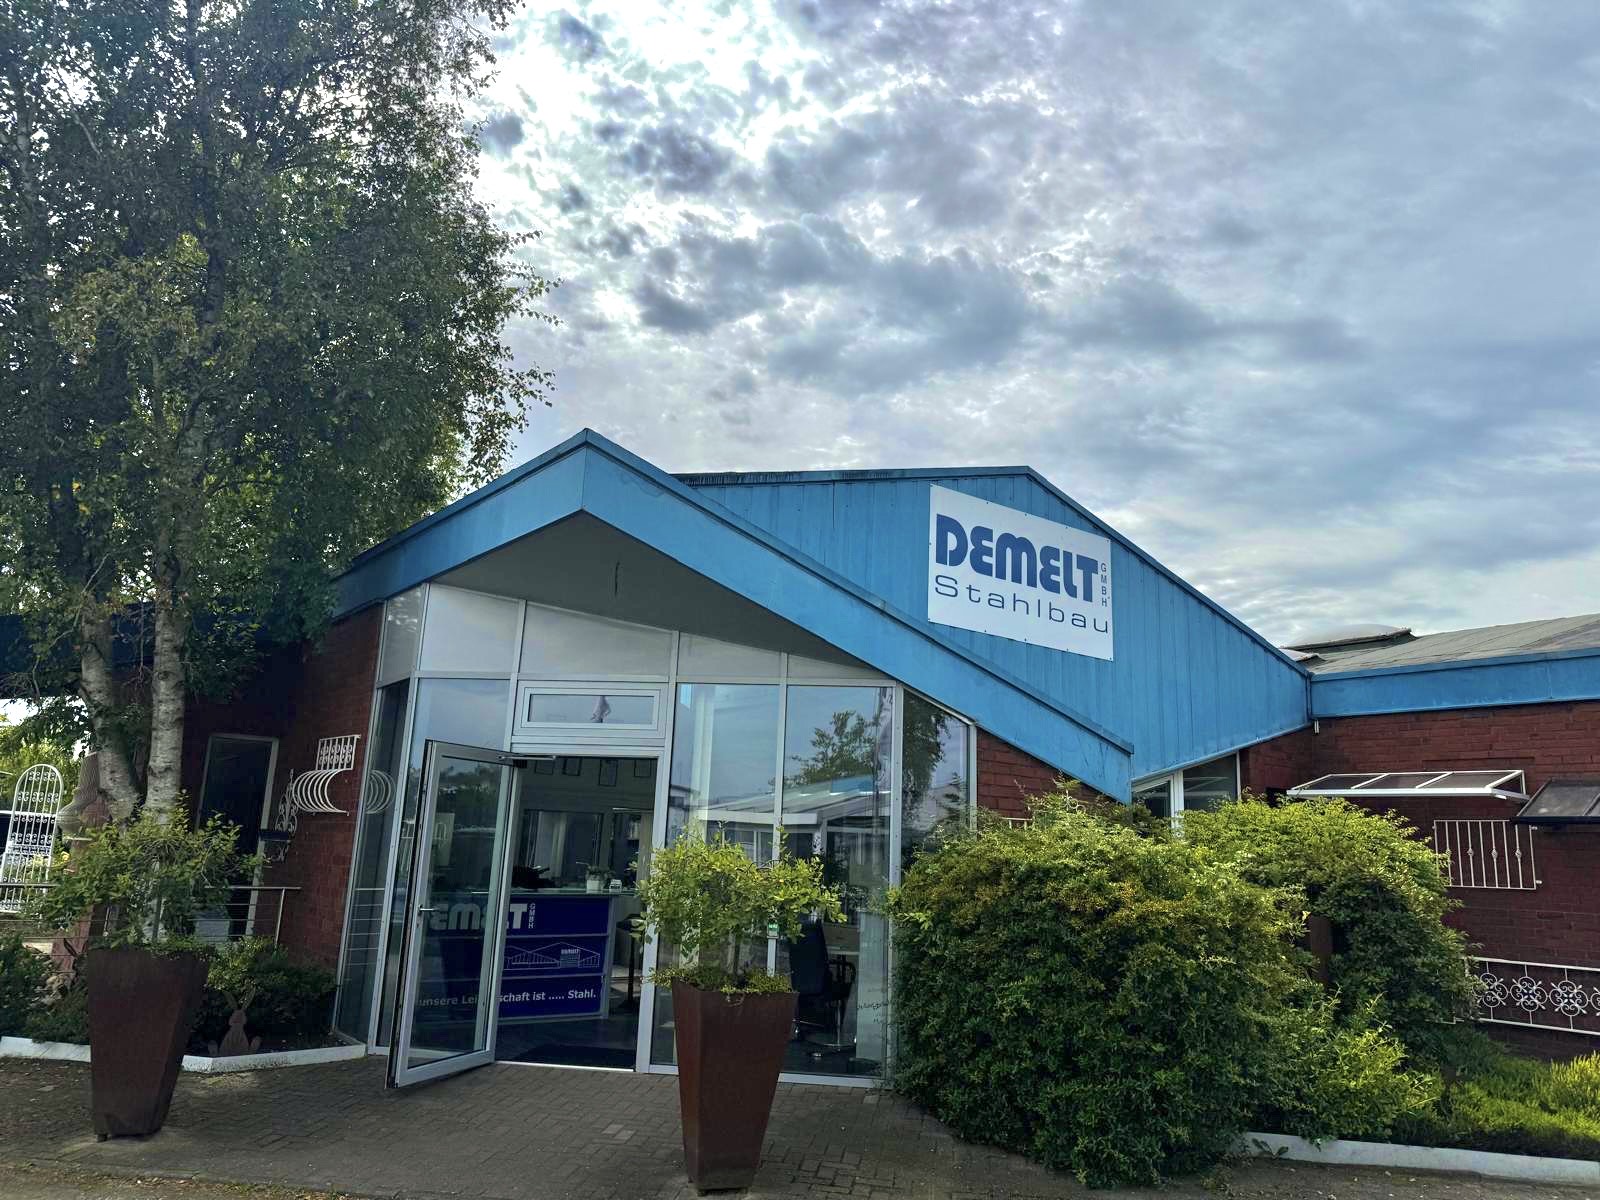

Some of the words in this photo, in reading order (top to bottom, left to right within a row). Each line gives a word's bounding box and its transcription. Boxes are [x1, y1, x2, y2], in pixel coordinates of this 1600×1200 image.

[935, 513, 1099, 603] DEMELT
[935, 574, 1108, 633] Stahlbau
[1100, 562, 1108, 607] GMBH
[532, 991, 547, 1001] ist
[567, 988, 597, 999] Stahl.
